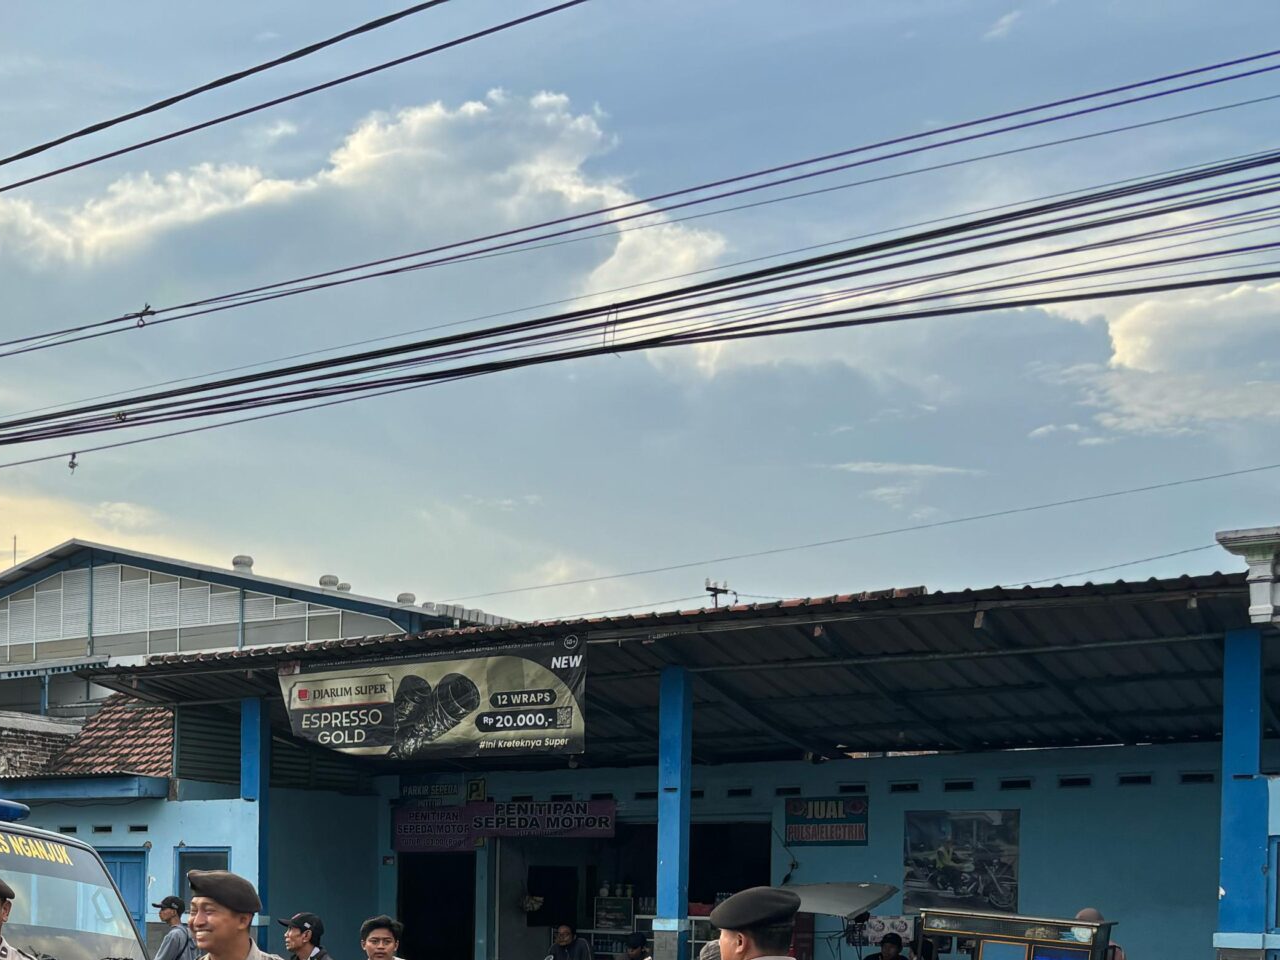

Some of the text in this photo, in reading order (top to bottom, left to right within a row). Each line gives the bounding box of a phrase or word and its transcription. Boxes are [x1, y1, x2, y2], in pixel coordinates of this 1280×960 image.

[551, 655, 582, 669] NEW
[313, 684, 387, 699] DJARUM SUPER
[497, 693, 551, 704] 12 WRAPS
[302, 709, 382, 728] ESPRESSO
[483, 713, 553, 728] Rp 20.000,-
[318, 729, 366, 744] GOLD
[479, 737, 569, 749] #Ini Kreteknya Super
[431, 786, 458, 795] SEPEDA
[409, 811, 459, 821] PENITIPAN
[495, 803, 588, 815] PENITIPAN
[807, 800, 847, 819] JUAL
[397, 824, 434, 834] SEPEDA
[473, 815, 610, 829] SEPEDA MOTOR
[787, 824, 817, 841] PULSA
[8, 834, 74, 866] NGANJUK
